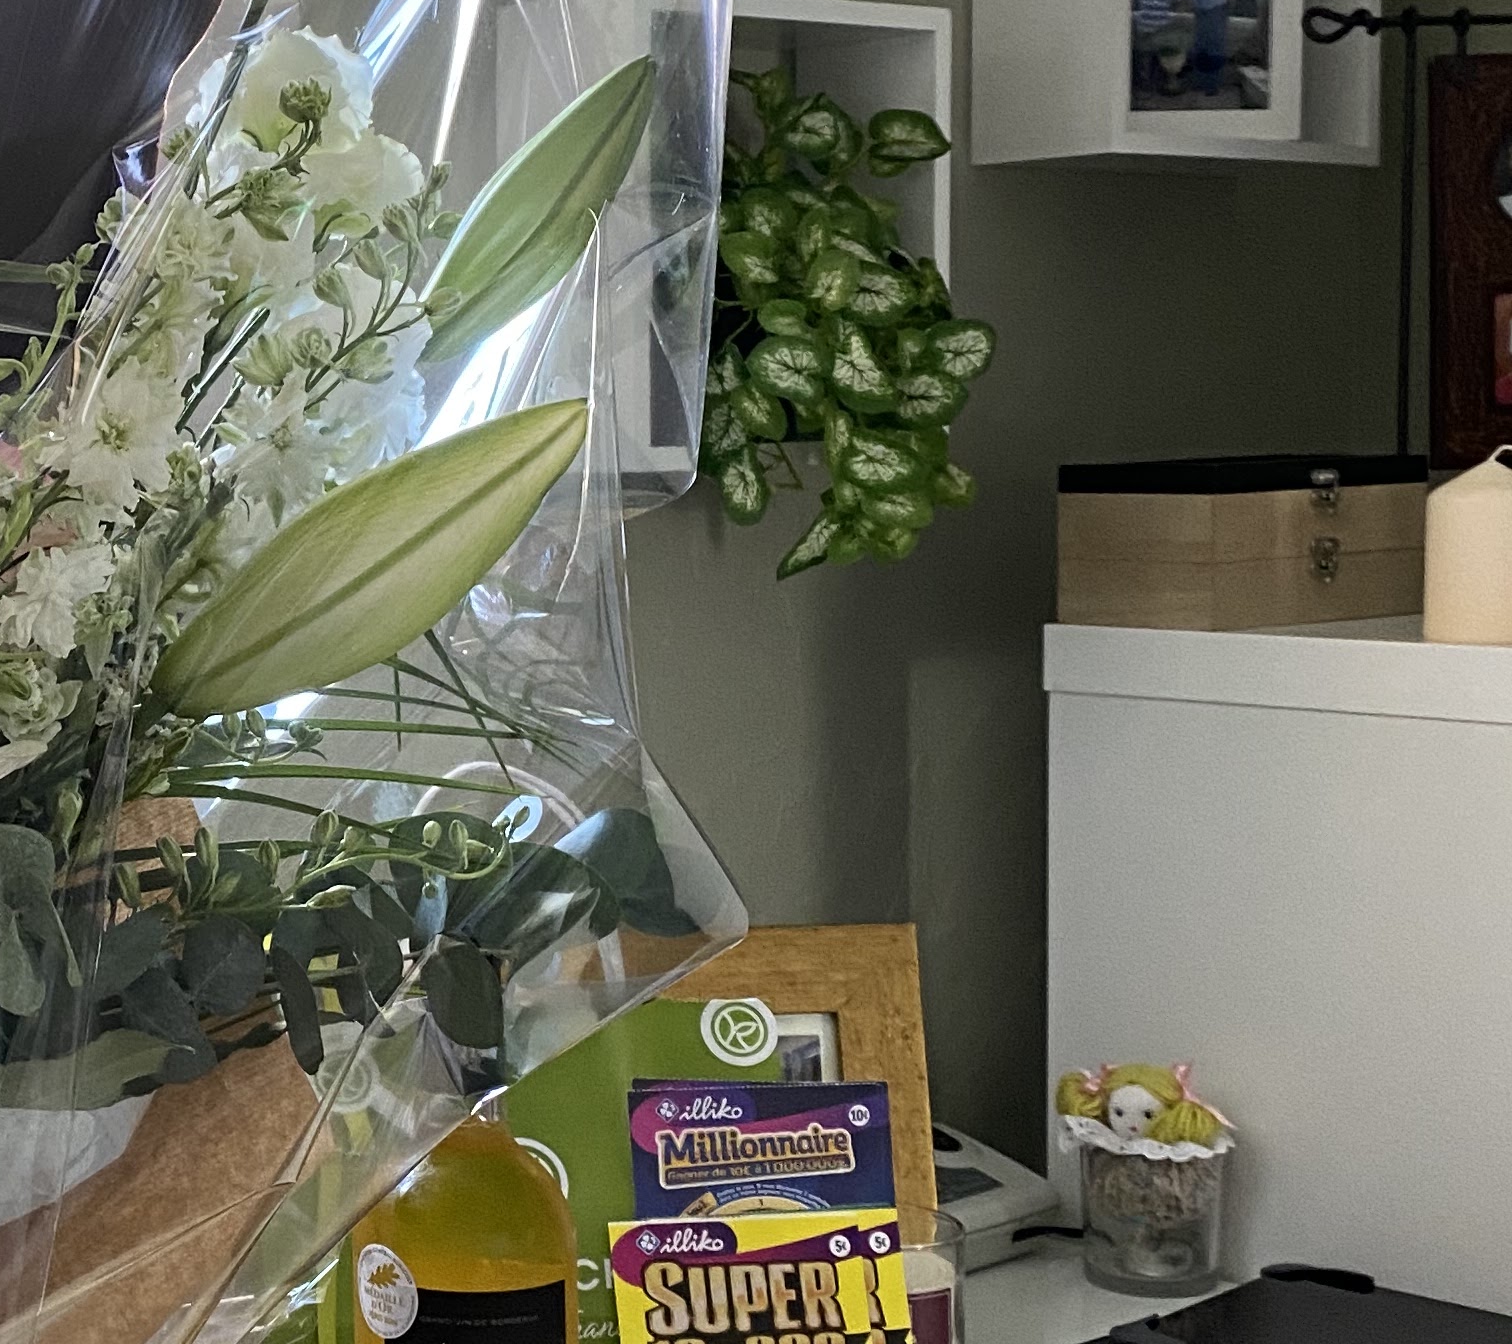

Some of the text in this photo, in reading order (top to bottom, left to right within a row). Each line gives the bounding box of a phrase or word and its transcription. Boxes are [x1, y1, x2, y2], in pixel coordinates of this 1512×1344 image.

[679, 1096, 743, 1121] illiko
[659, 1123, 850, 1166] Millionnaire
[660, 1227, 725, 1255] illiko
[644, 1260, 842, 1336] SUPER
